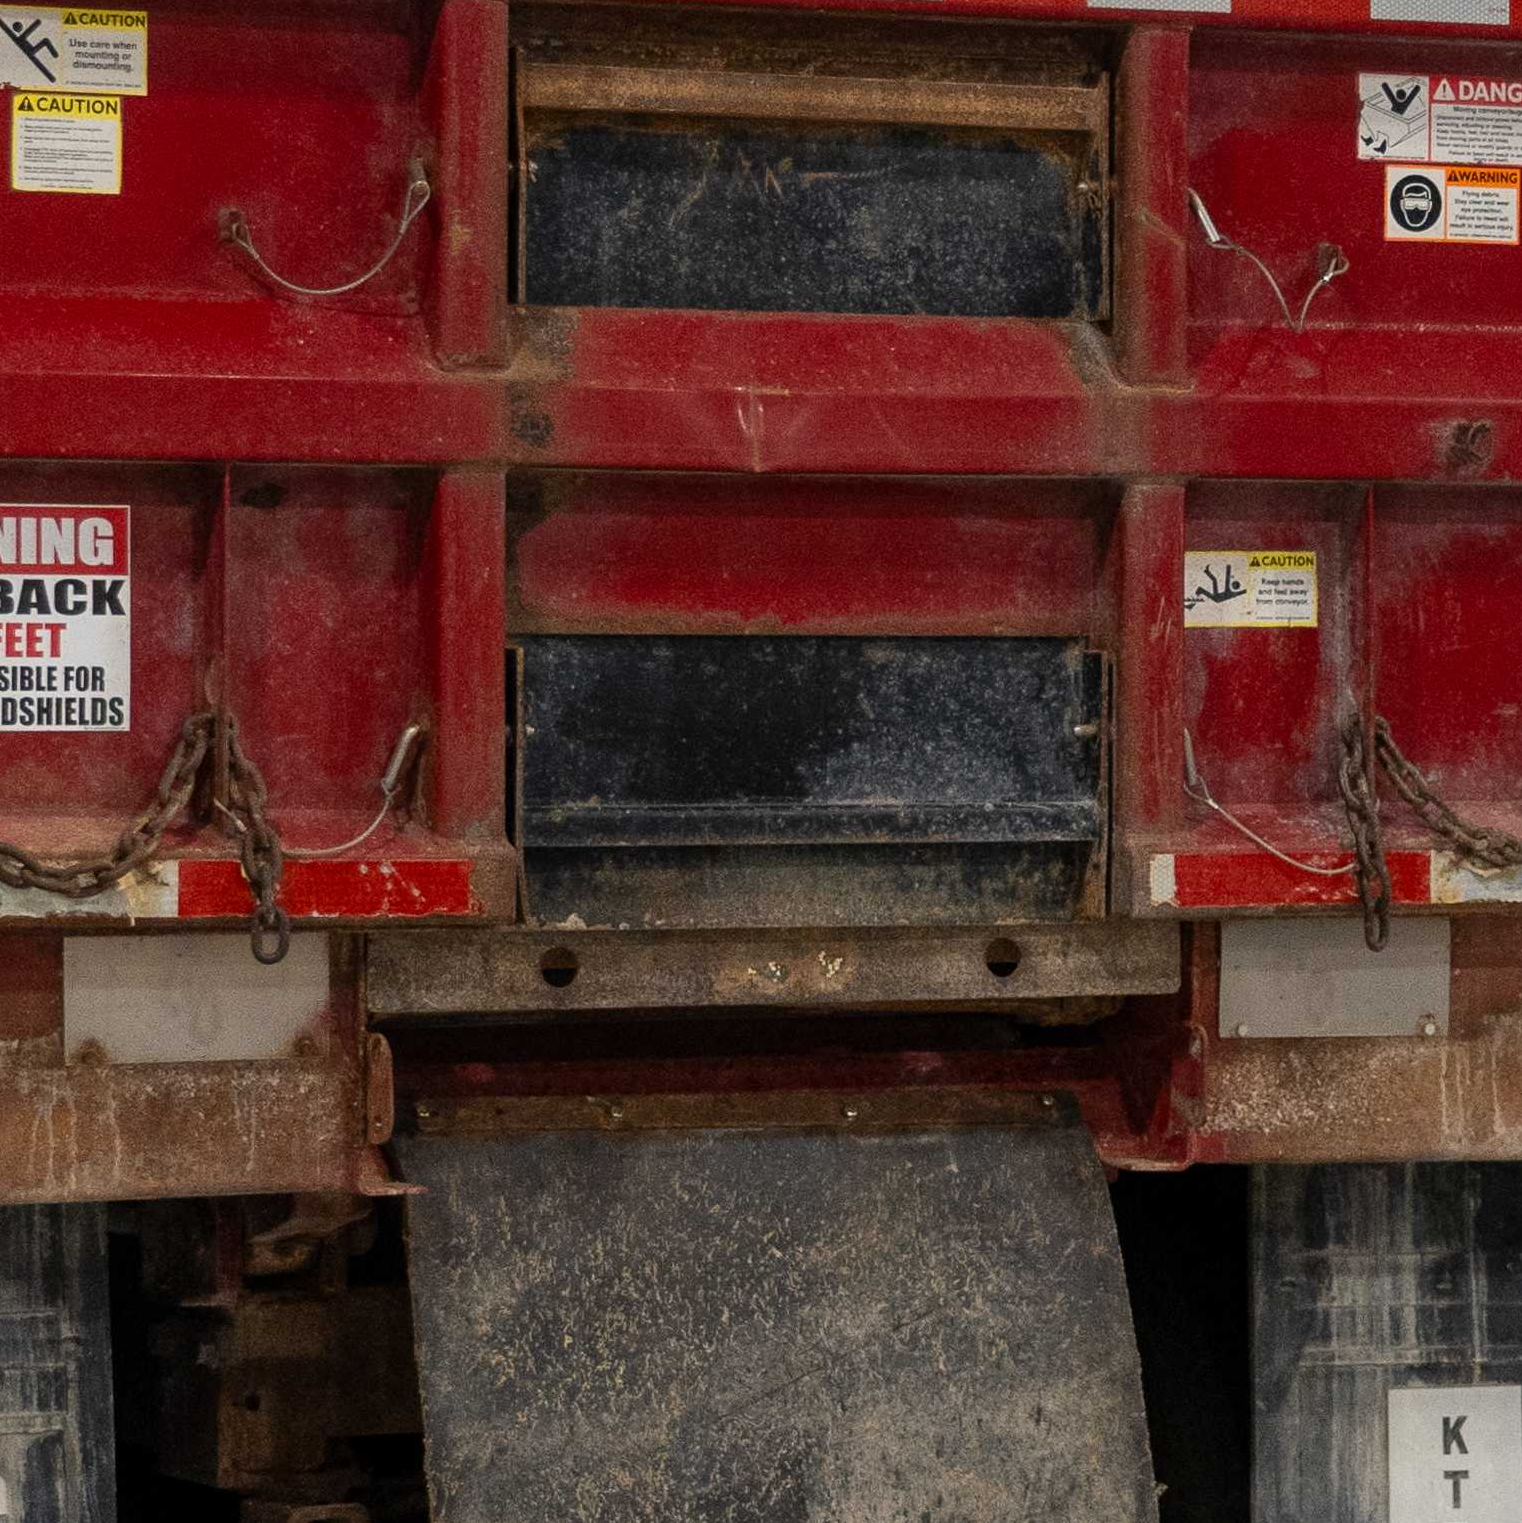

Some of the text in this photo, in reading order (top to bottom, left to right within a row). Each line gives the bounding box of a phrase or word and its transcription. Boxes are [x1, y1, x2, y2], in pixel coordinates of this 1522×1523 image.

[79, 12, 146, 28] CAUTION
[69, 38, 138, 50] Use care when
[75, 51, 133, 61] mounting or
[36, 97, 118, 115] CAUTION
[1458, 171, 1518, 184] WARNING
[1261, 555, 1314, 567] CAUTION
[64, 666, 106, 692] FOR
